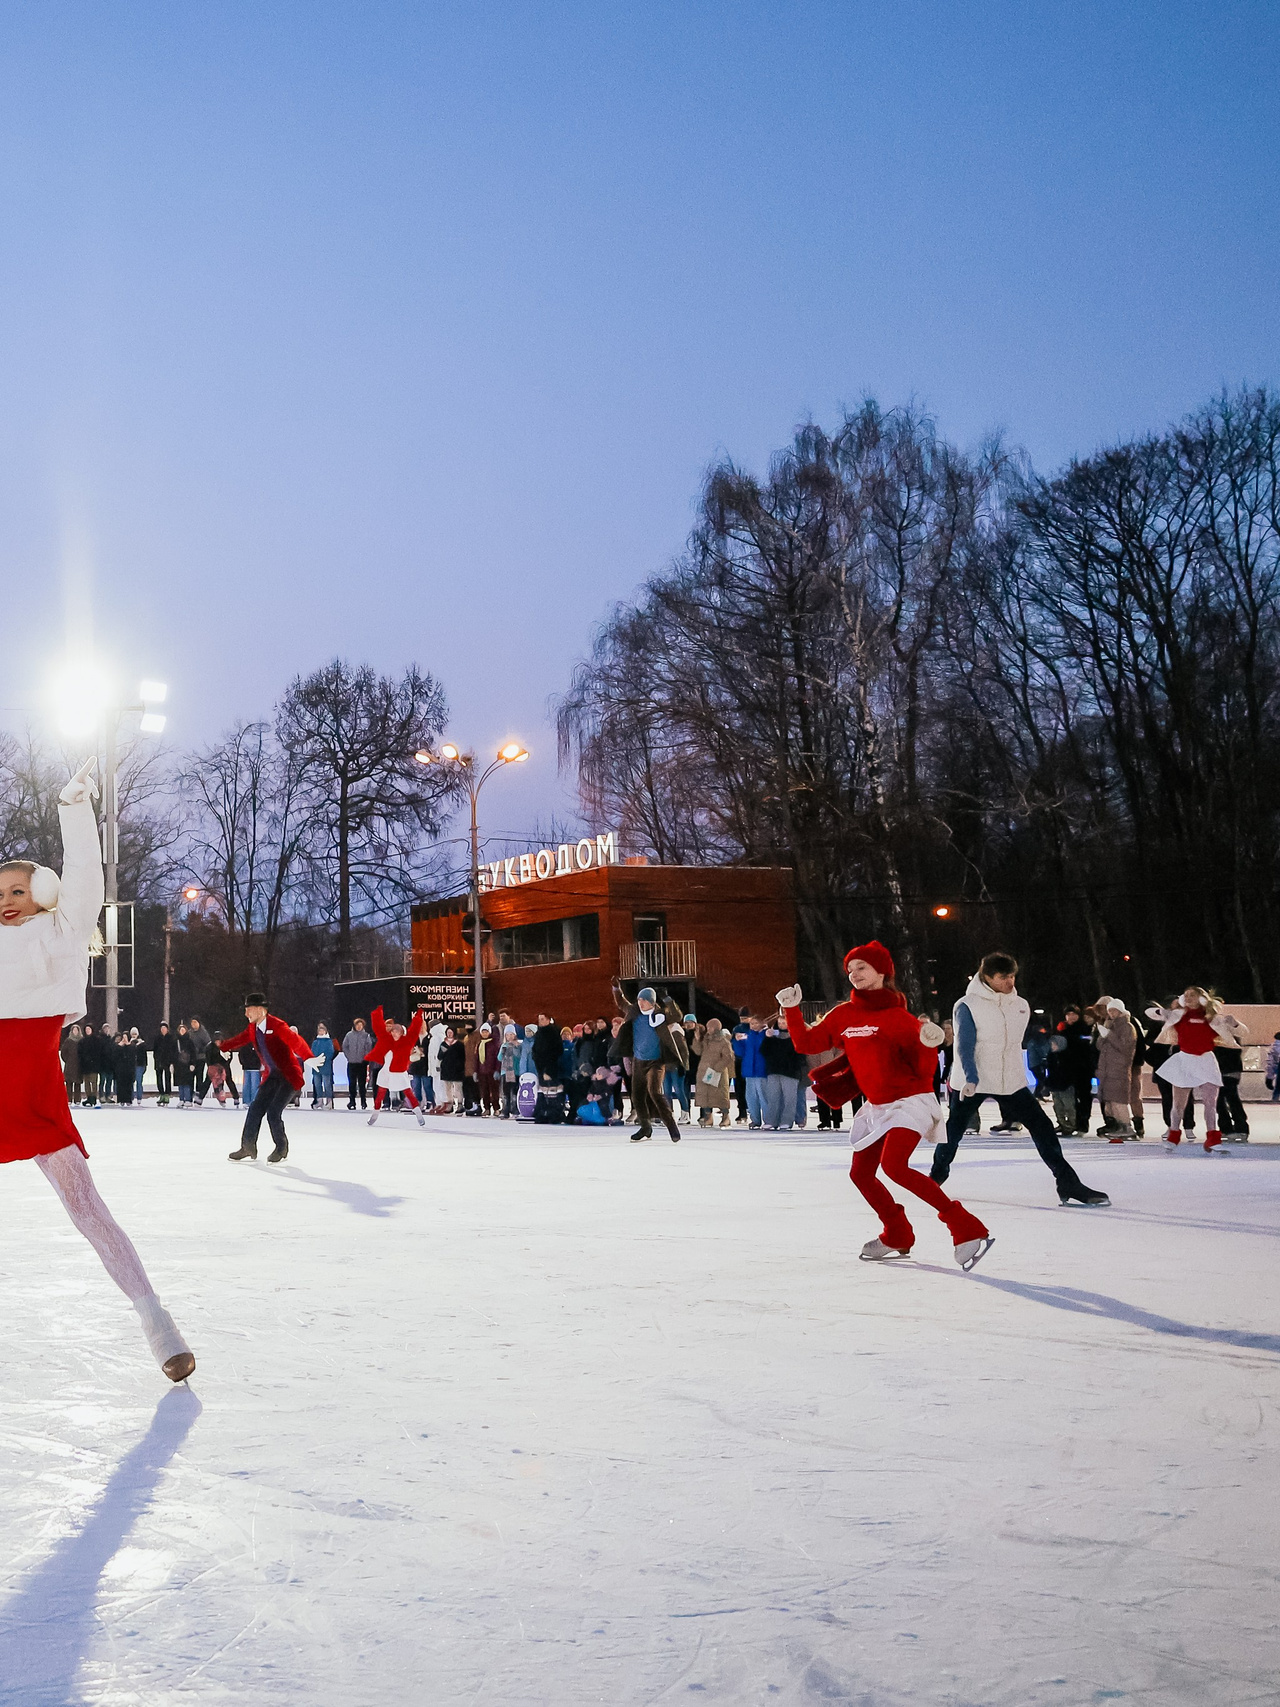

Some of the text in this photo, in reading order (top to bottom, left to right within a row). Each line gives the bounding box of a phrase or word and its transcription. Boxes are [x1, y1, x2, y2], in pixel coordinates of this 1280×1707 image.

[409, 985, 470, 994] ЭКОМАГАЗИН
[443, 1001, 484, 1013] КАФ
[411, 1011, 444, 1020] КИГИ
